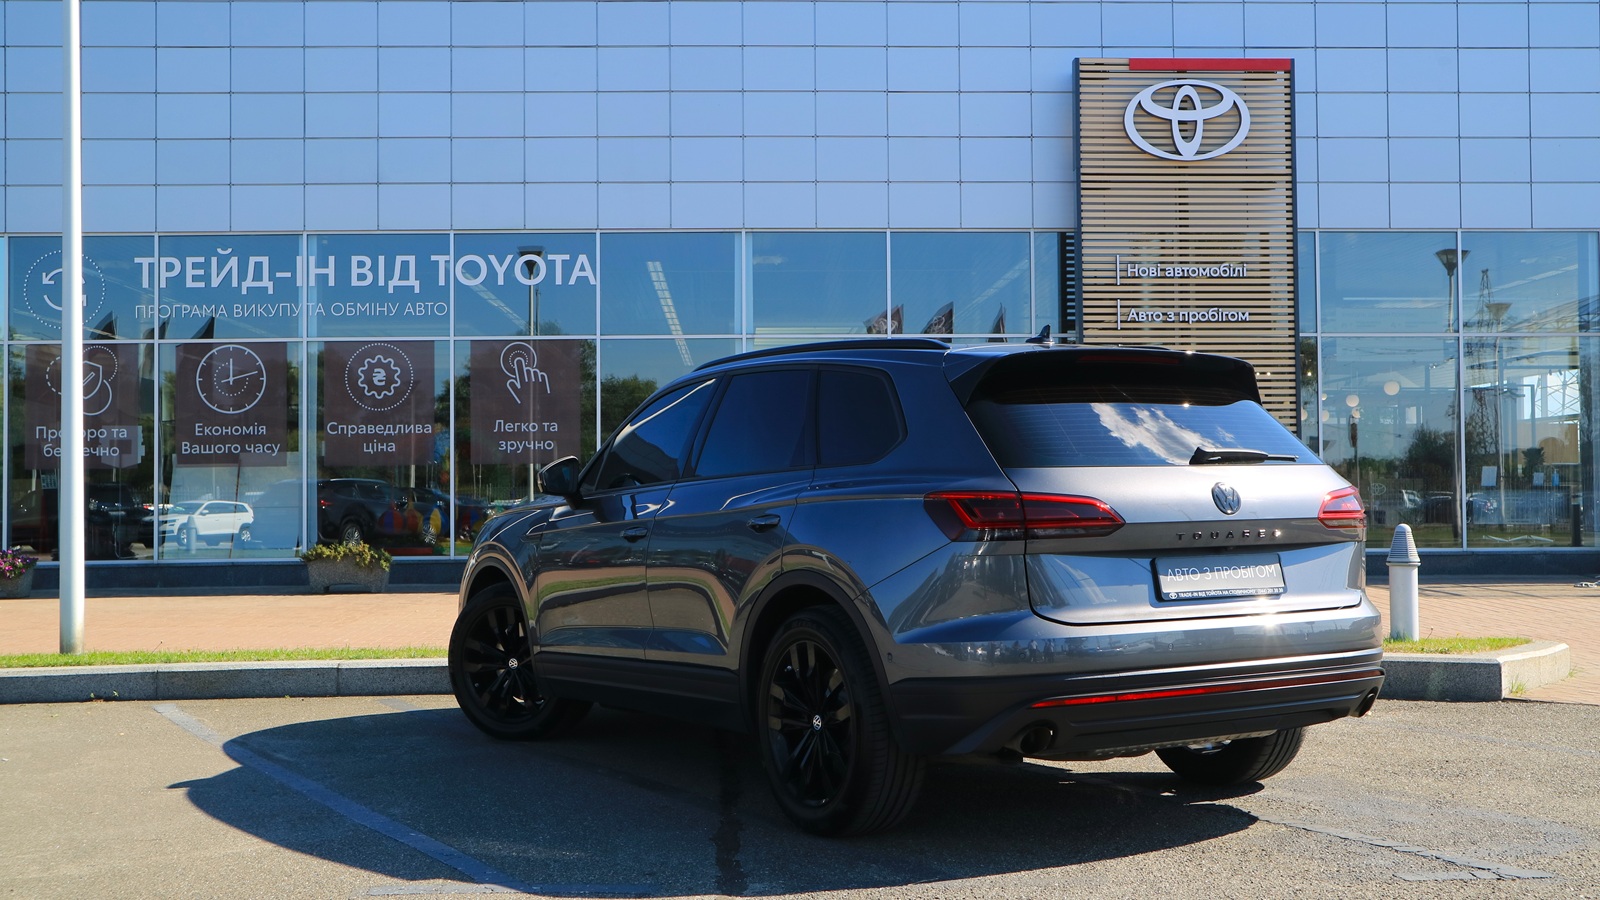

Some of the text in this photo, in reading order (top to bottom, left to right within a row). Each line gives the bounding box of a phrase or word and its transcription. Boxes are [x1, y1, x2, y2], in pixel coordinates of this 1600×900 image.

[134, 248, 597, 294] ТРЕЙД-ІН ВІД TOYOTA
[1127, 263, 1247, 277] Нові автомобілі
[135, 302, 448, 319] ПРОГРАМА ВИКУПУ ТА ОБМІНУ АВТО
[1127, 308, 1250, 325] Авто з пробігом
[35, 426, 128, 442] Прро та
[195, 423, 266, 436] Економія
[326, 422, 432, 437] Справедлива
[493, 420, 558, 433] Легко та
[43, 443, 120, 457] беечно
[181, 441, 281, 456] Вашого часу
[363, 440, 396, 453] ціна
[498, 440, 554, 454] зручно
[1167, 567, 1200, 582] АВТО
[1214, 564, 1277, 580] ПРОБІГОМ
